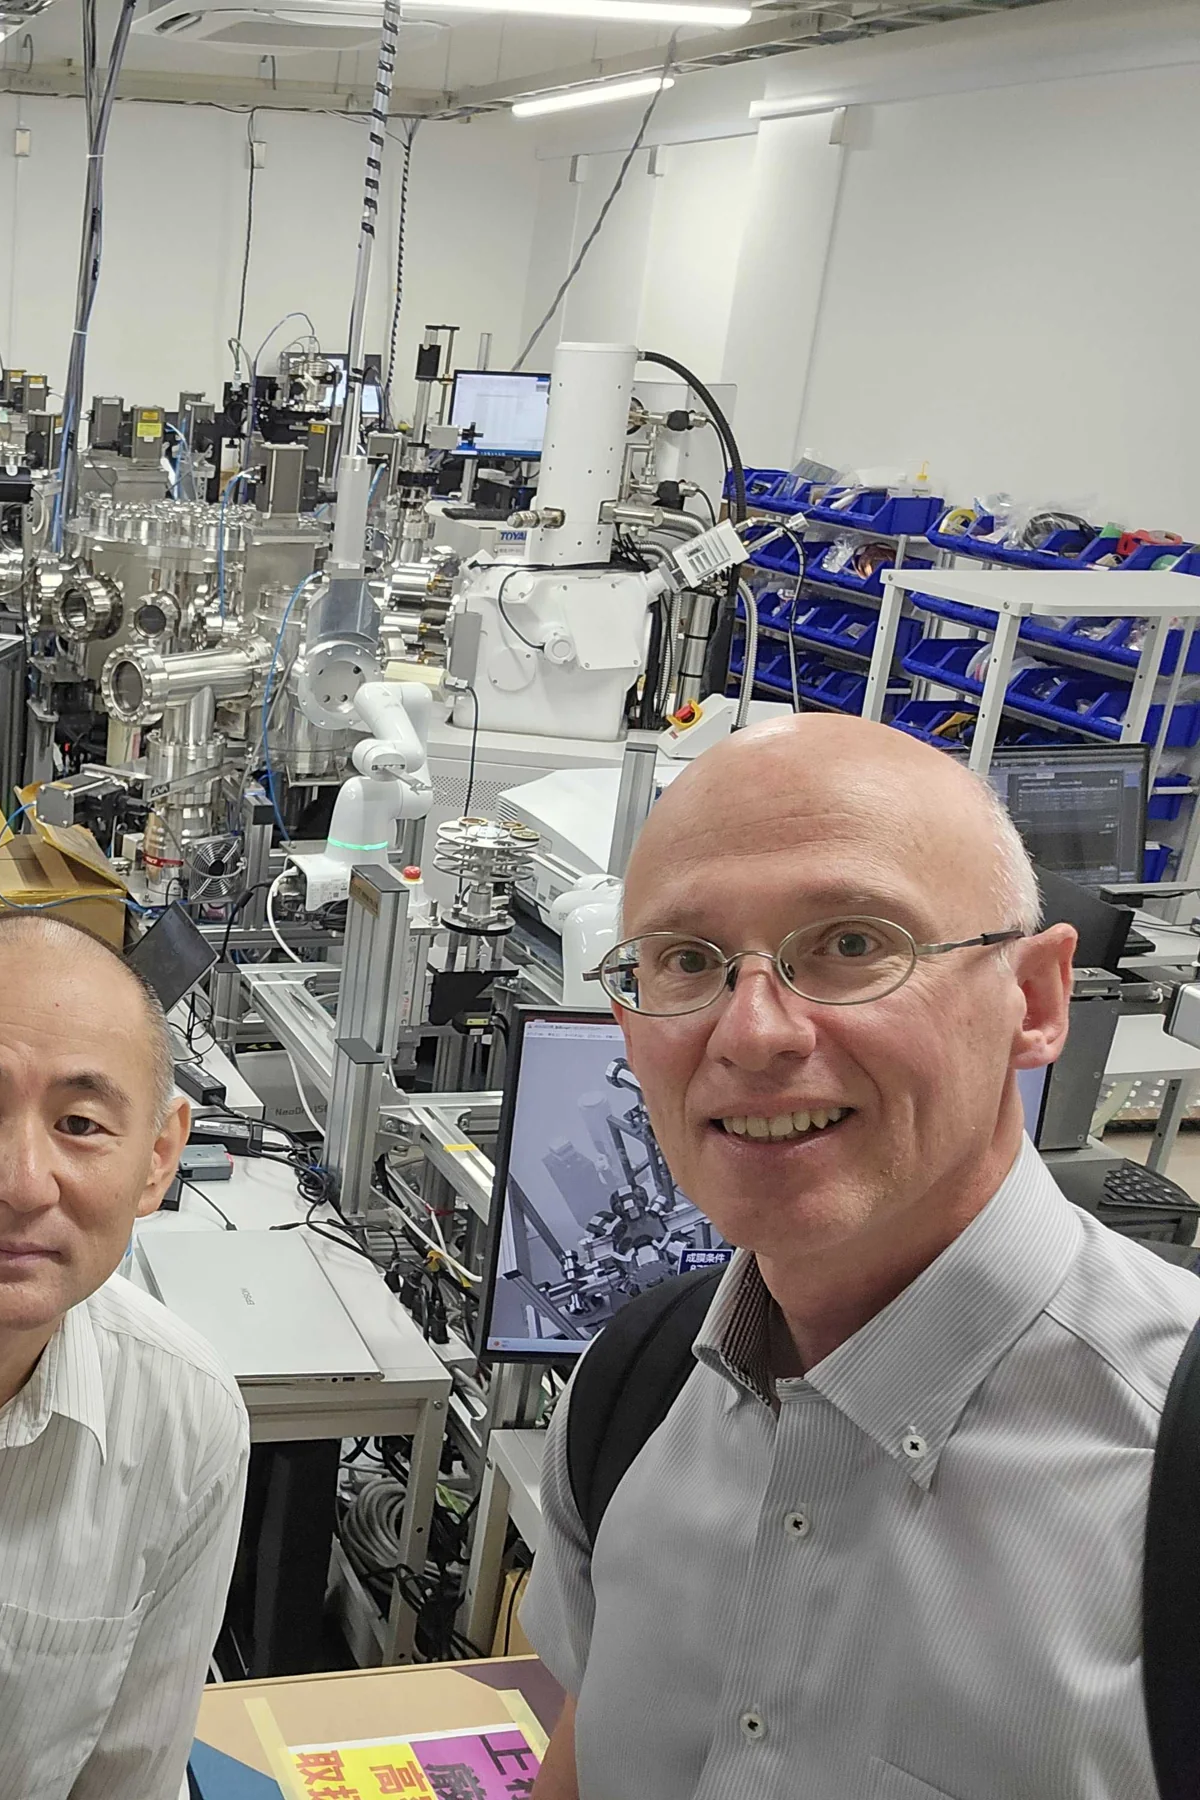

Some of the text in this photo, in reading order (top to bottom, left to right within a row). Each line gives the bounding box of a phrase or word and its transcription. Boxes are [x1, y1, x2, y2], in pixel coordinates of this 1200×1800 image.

[685, 1252, 726, 1264] 成膜条件
[369, 1760, 437, 1800] 高
